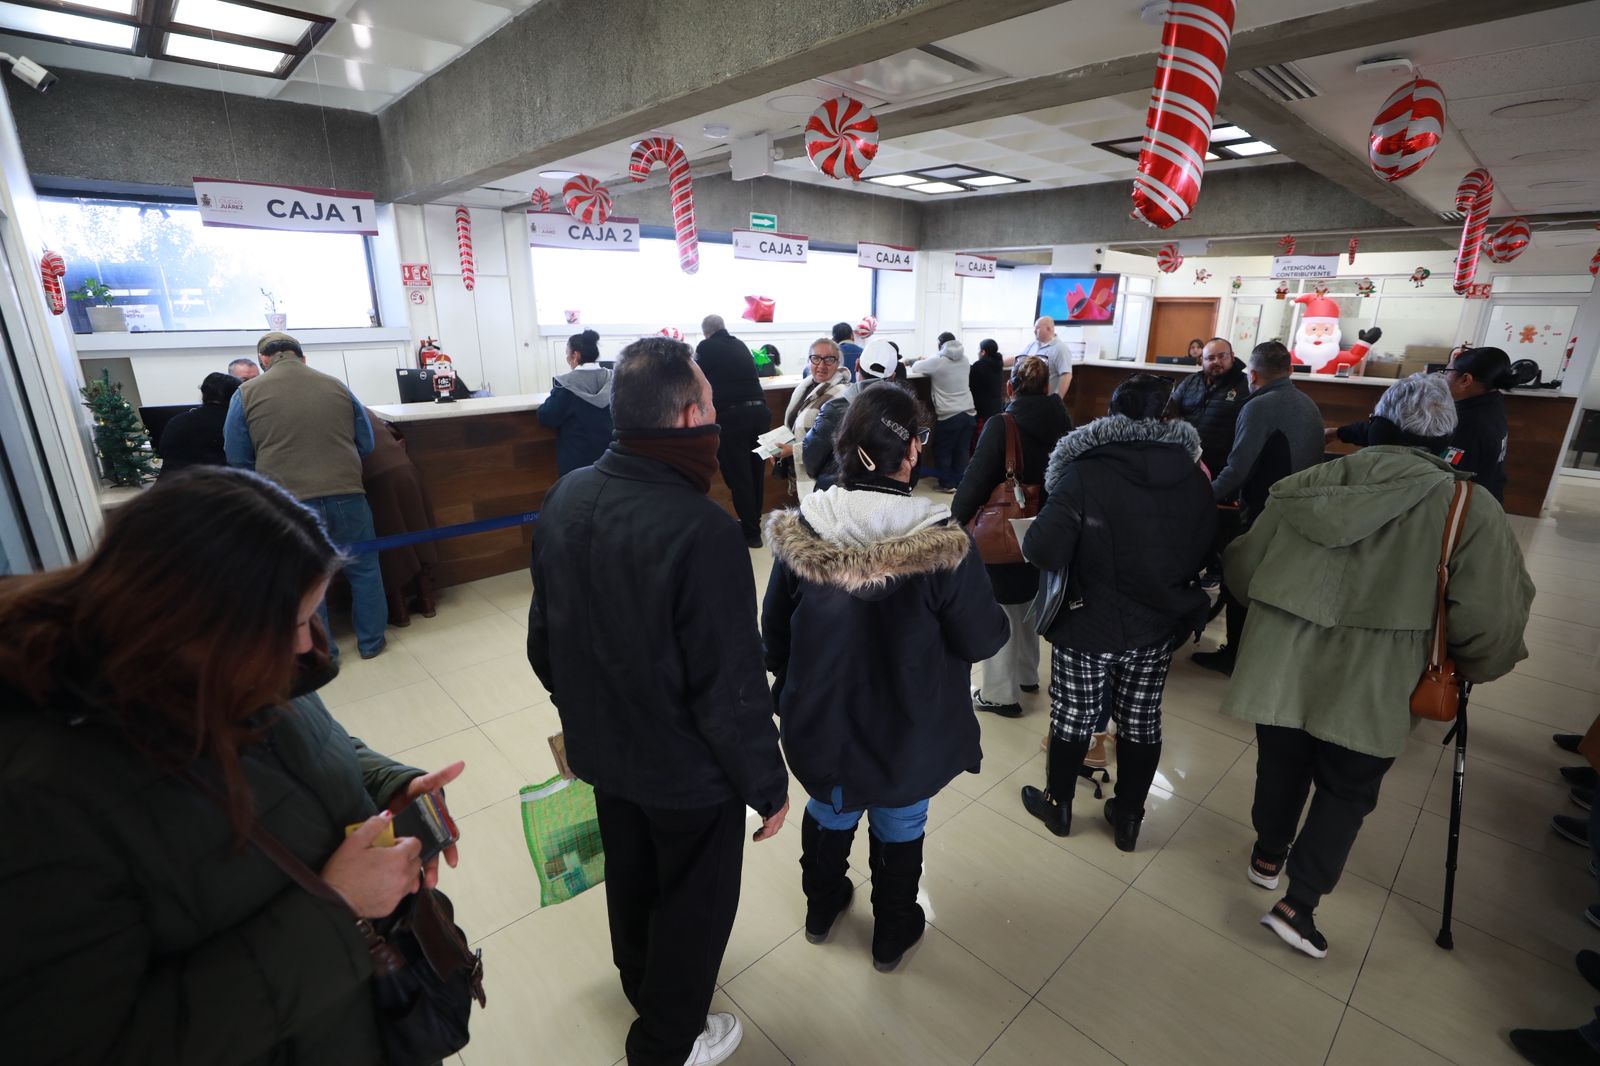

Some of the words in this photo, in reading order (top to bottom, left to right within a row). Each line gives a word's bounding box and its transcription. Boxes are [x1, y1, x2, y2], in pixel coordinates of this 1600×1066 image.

[267, 199, 345, 222] CAJA
[351, 205, 363, 223] 1
[568, 225, 617, 242] CAJA
[623, 228, 633, 243] 2
[759, 241, 793, 255] CAJA
[796, 244, 804, 256] 3
[876, 252, 901, 264] CAJA
[903, 255, 910, 265] 4
[968, 261, 987, 272] CAJA
[988, 263, 994, 273] 5
